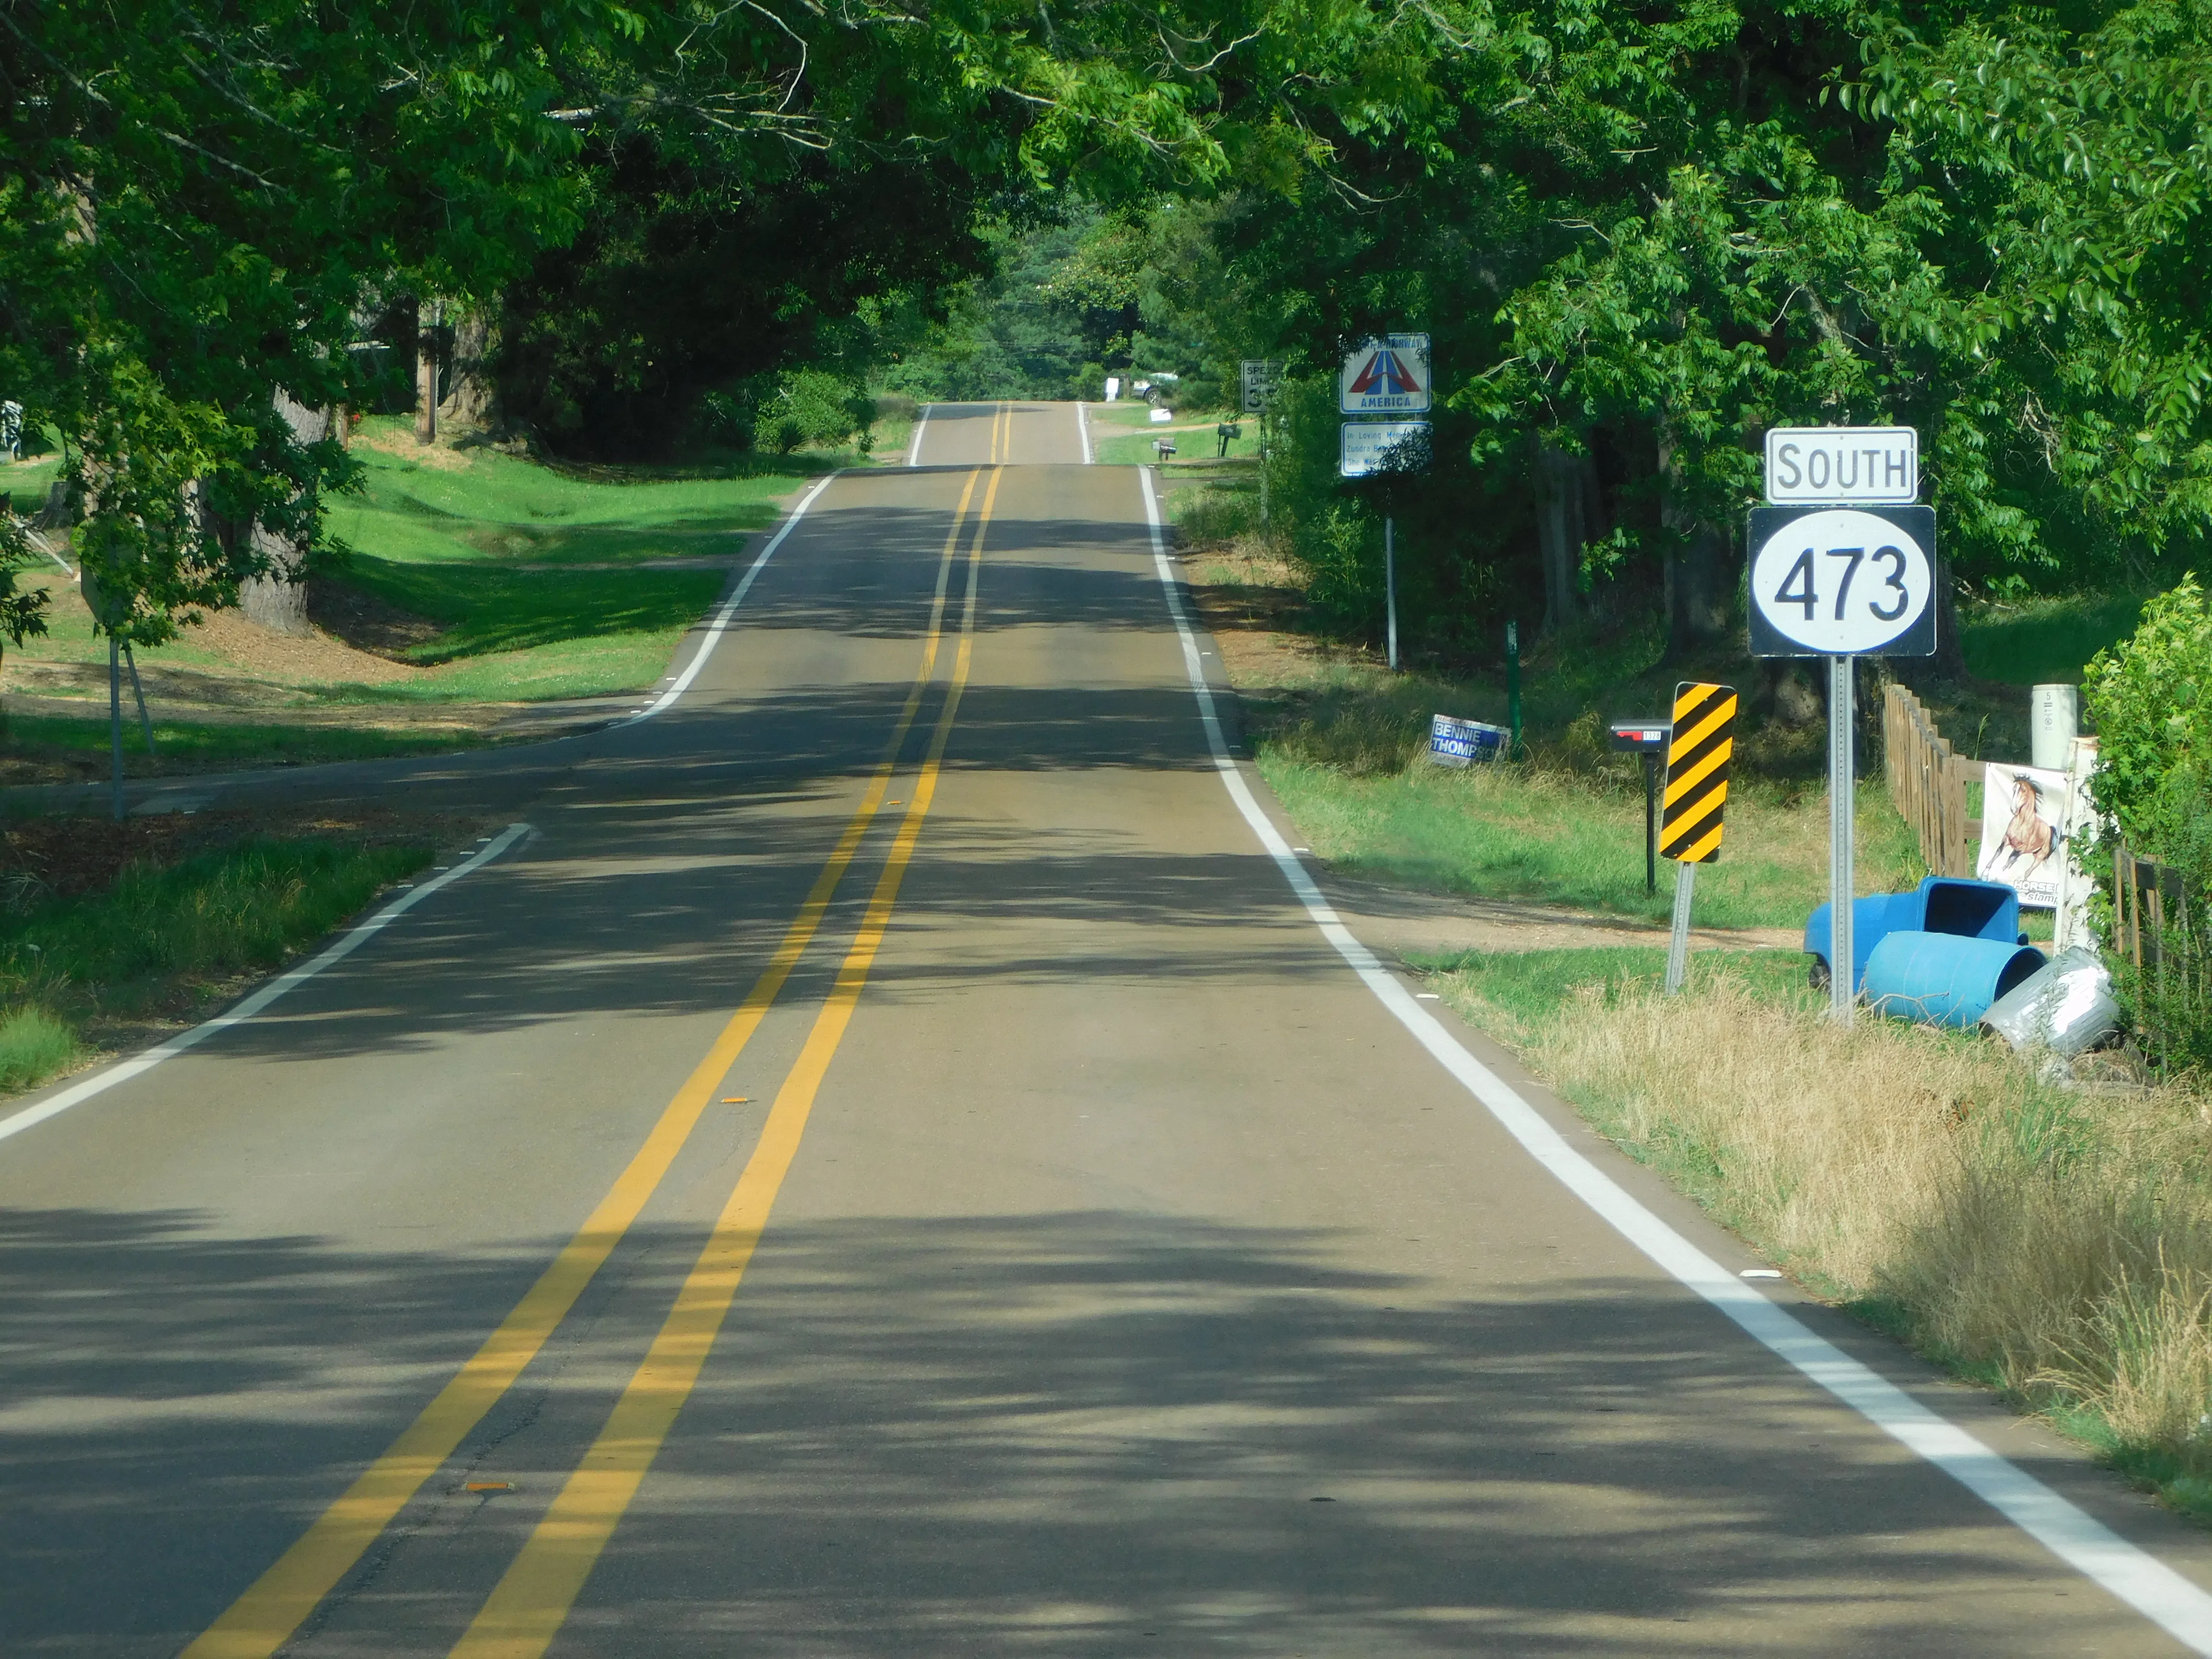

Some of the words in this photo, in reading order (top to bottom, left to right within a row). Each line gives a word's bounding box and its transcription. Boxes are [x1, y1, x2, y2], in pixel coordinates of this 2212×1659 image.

[1360, 397, 1410, 407] AMERICA
[1358, 432, 1381, 441] Loving
[1346, 445, 1370, 453] Zundra
[1777, 443, 1907, 490] SOUTH
[1774, 545, 1909, 621] 473
[2046, 692, 2051, 700] 5
[1434, 722, 1481, 743] BENNIE
[1432, 737, 1496, 760] THOMPSO
[2014, 879, 2055, 893] HORSE
